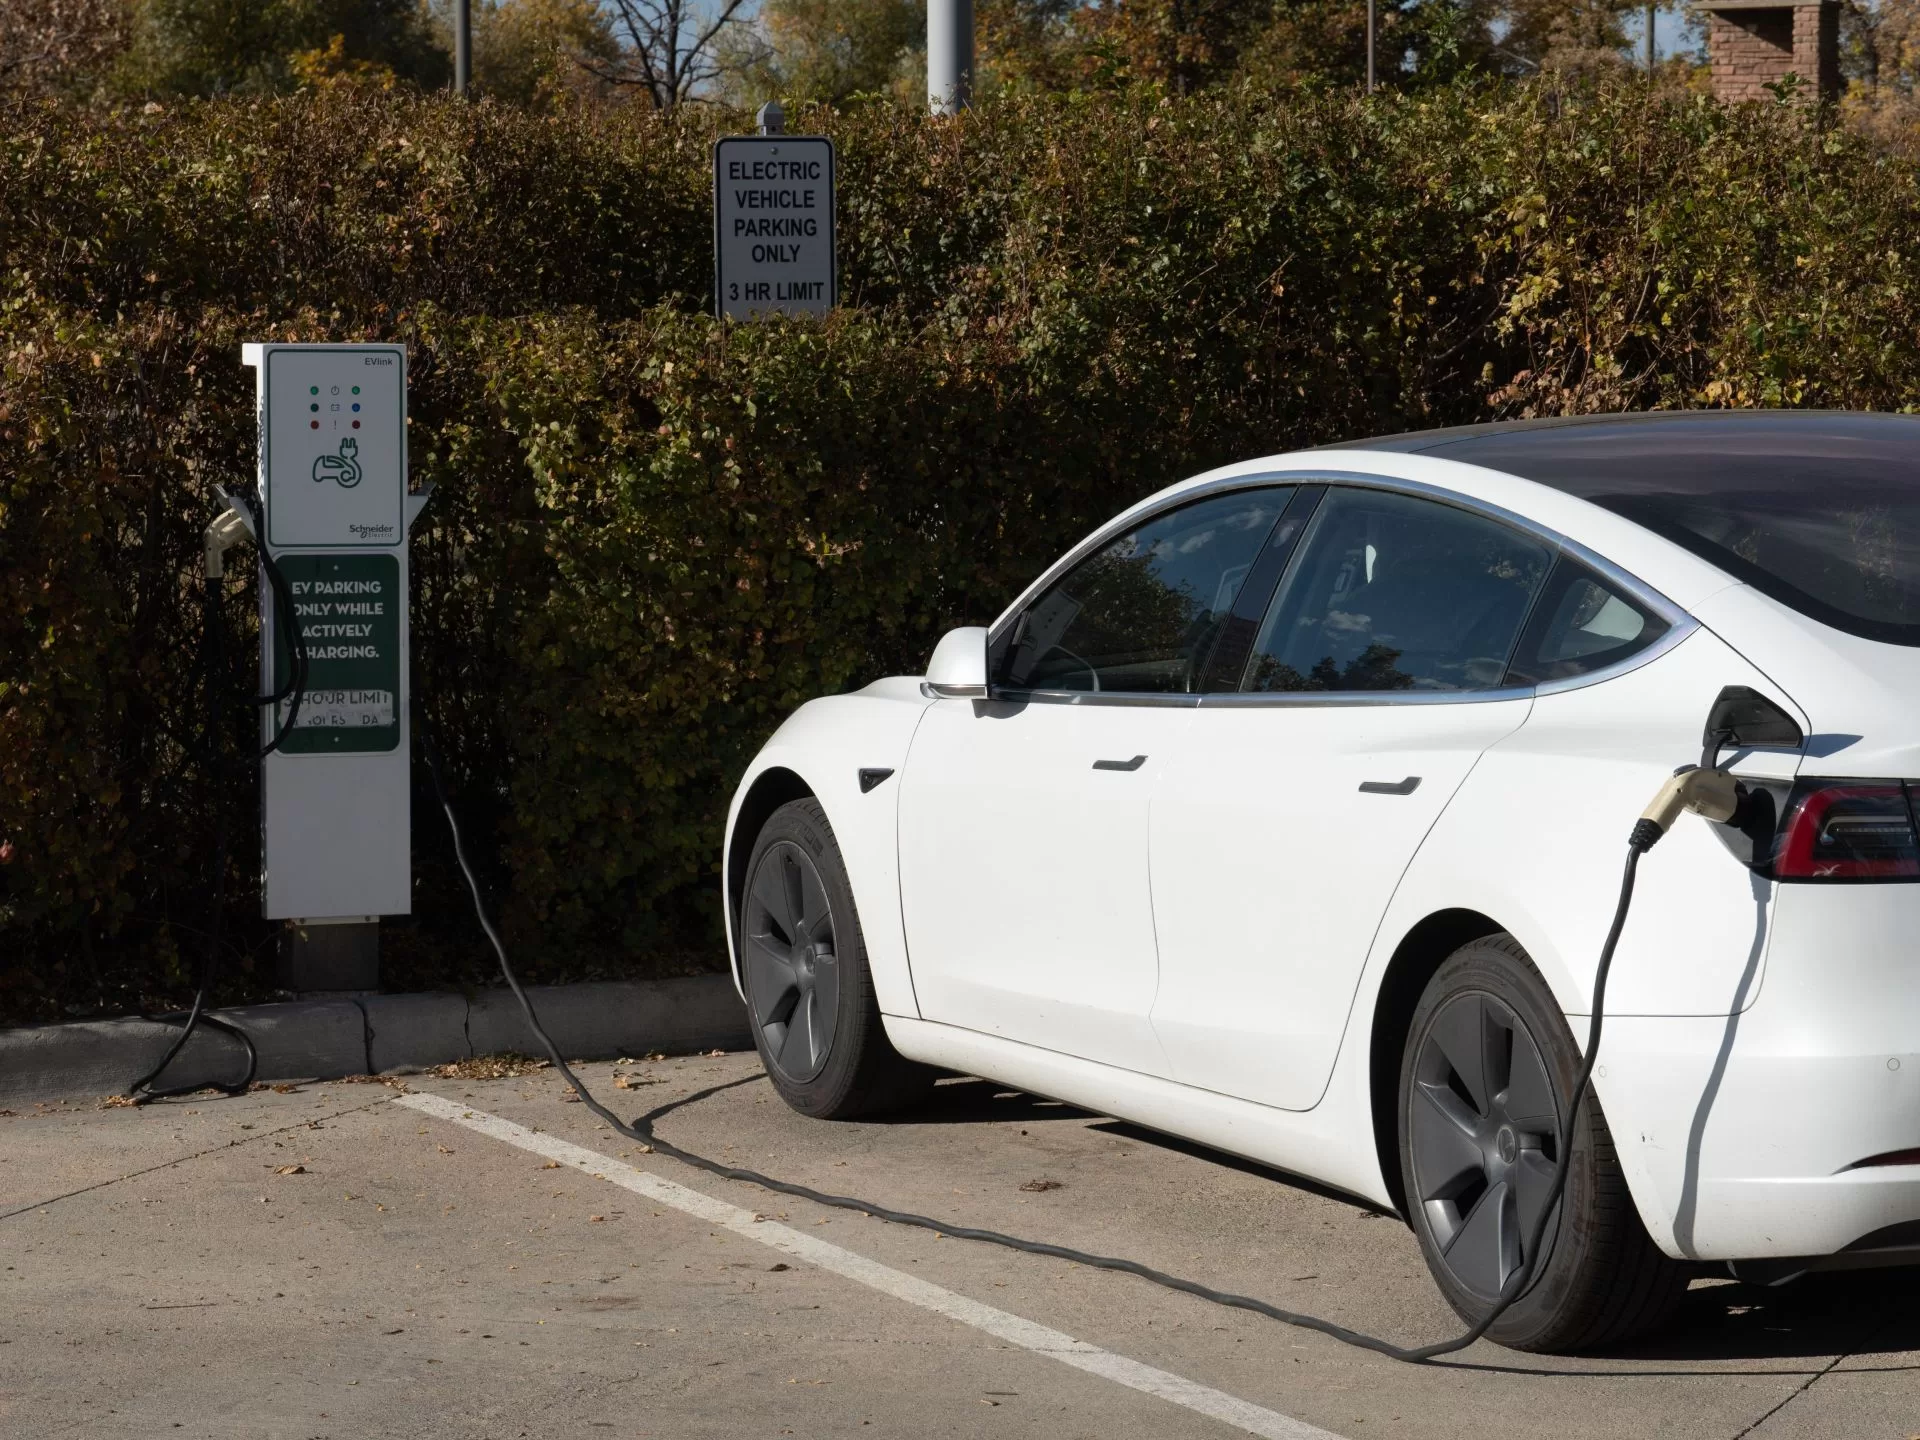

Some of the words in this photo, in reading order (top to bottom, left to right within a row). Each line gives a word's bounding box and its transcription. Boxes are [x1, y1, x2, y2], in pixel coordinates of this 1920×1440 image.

[729, 162, 821, 181] ELECTRIC
[736, 190, 815, 209] VEHICLE
[734, 218, 817, 237] PARKING
[752, 244, 801, 263] ONLY
[729, 283, 739, 301] 3
[745, 282, 771, 301] HR
[777, 281, 825, 301] LIMIT
[364, 357, 393, 366] EVlink
[349, 524, 394, 533] Schneider
[291, 581, 311, 595] EV
[314, 580, 382, 594] PARKING
[334, 602, 385, 615] WHILE
[301, 623, 373, 637] ACTIVELY
[300, 692, 345, 704] HOUR
